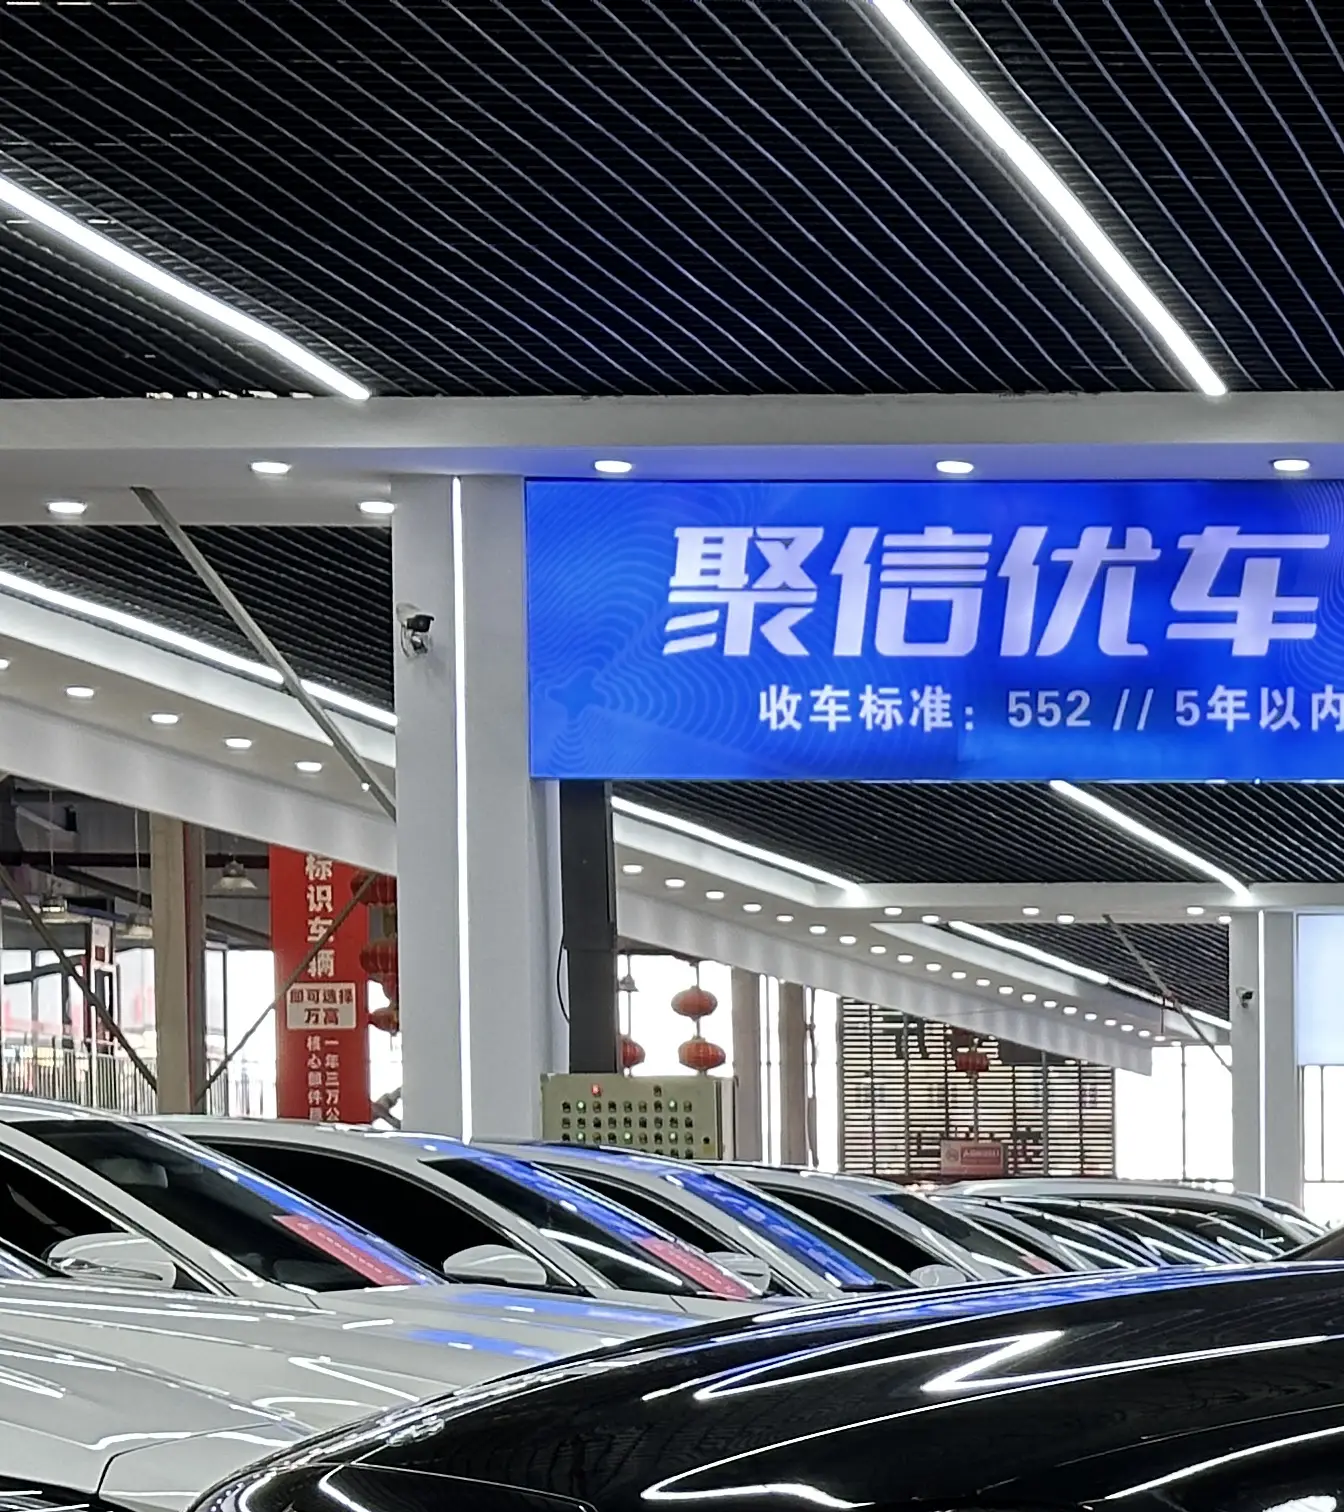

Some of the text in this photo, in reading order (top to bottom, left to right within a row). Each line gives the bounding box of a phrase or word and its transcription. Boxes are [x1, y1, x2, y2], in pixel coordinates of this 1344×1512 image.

[663, 526, 1330, 658] 聚信优车
[1009, 691, 1091, 728] 552
